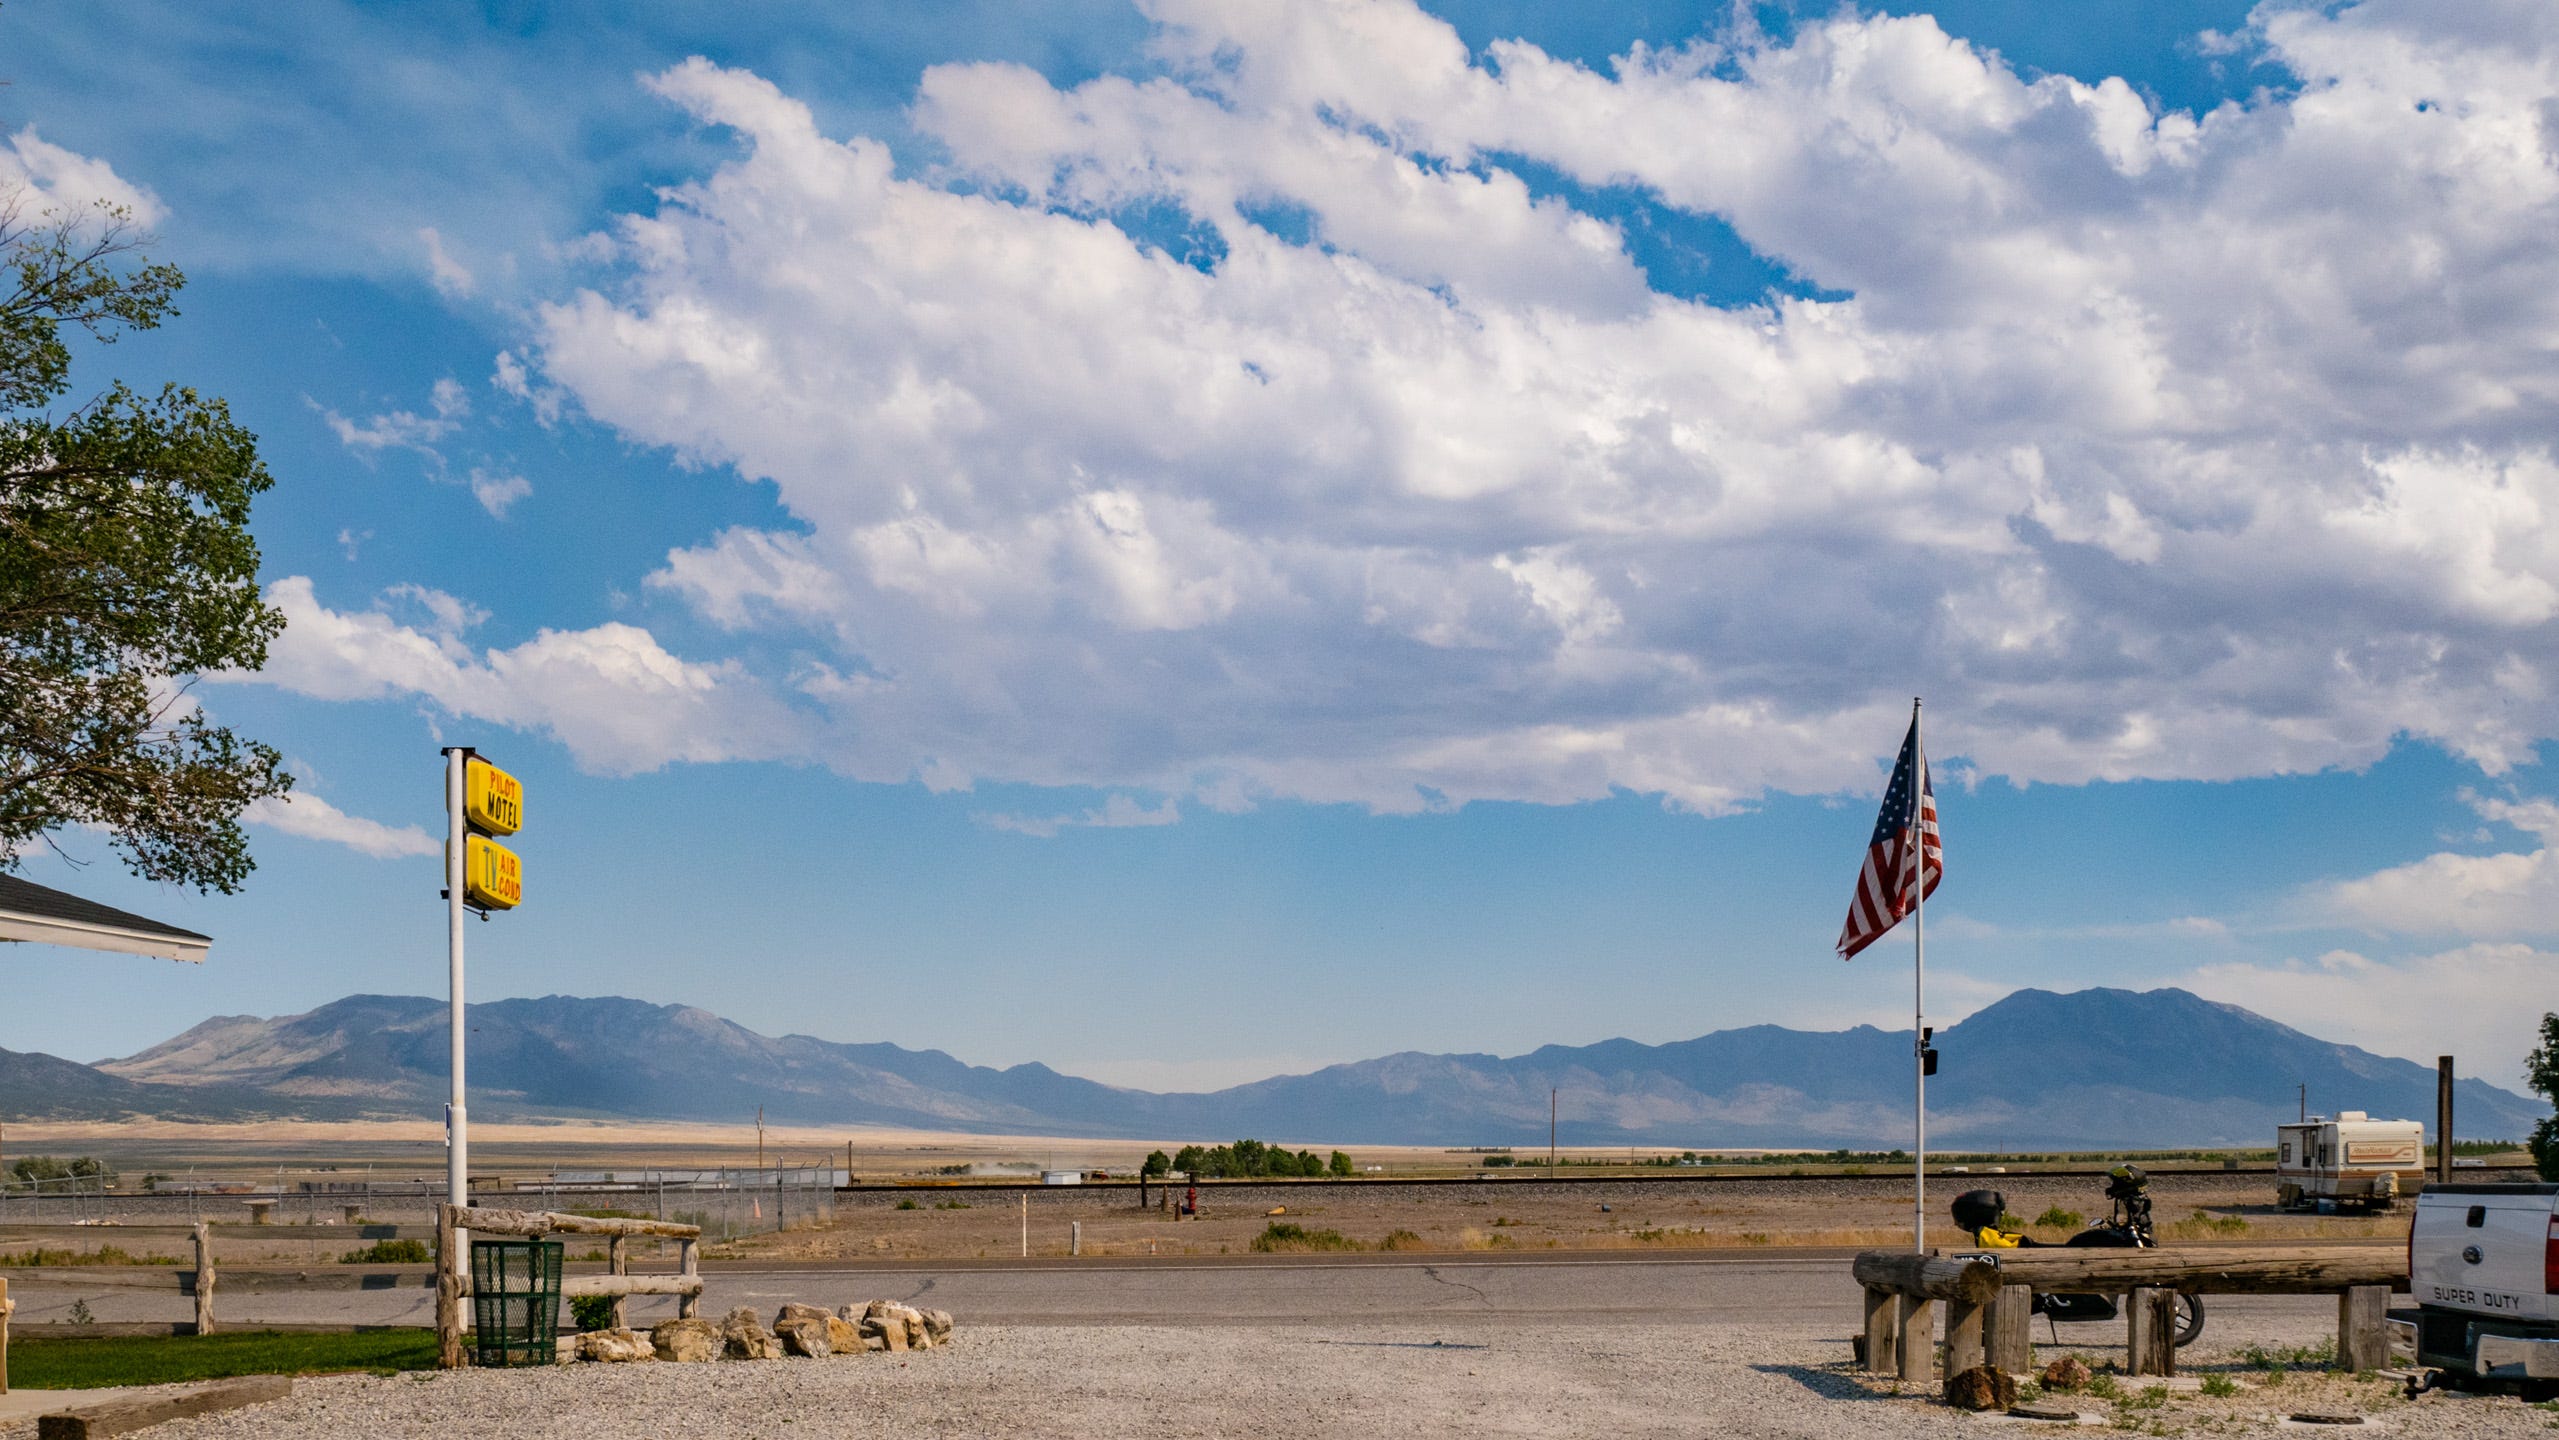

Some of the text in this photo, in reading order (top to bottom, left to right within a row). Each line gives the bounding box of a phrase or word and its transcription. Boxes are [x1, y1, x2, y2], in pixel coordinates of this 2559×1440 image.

[490, 771, 515, 800] PILOT
[487, 791, 517, 828] MOTEL
[483, 846, 498, 891] TV
[499, 854, 515, 877] AIR
[2434, 1287, 2519, 1309] SUPER DUTY
